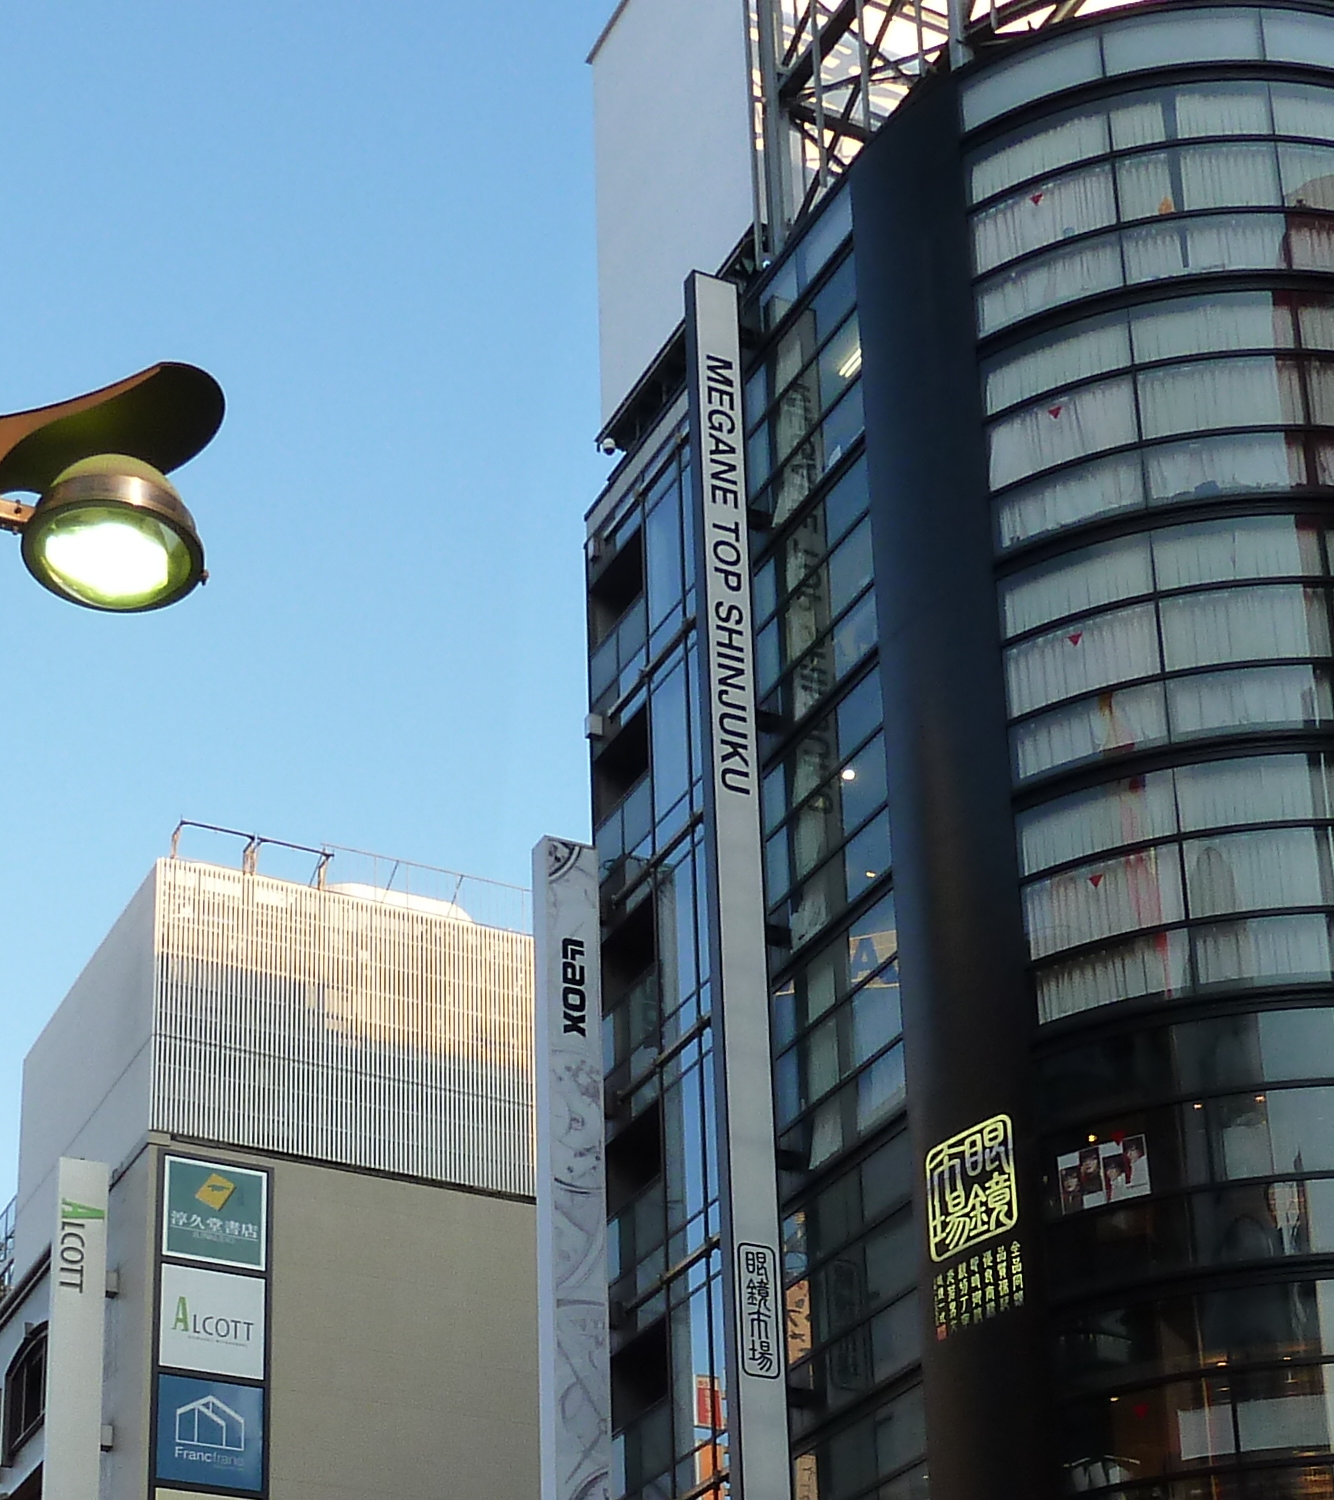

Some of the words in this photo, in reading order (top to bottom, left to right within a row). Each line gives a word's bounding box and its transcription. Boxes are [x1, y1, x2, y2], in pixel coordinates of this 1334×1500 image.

[705, 354, 740, 511] MEGANE
[711, 520, 744, 593] TOP
[714, 599, 751, 797] SHINJUKU
[58, 1198, 106, 1294] ALCOTT
[170, 1209, 259, 1240] 淳久堂書店
[170, 1295, 255, 1342] ALCOTT
[744, 1250, 775, 1373] 眼鏡市場
[174, 1446, 246, 1468] Francfranc
